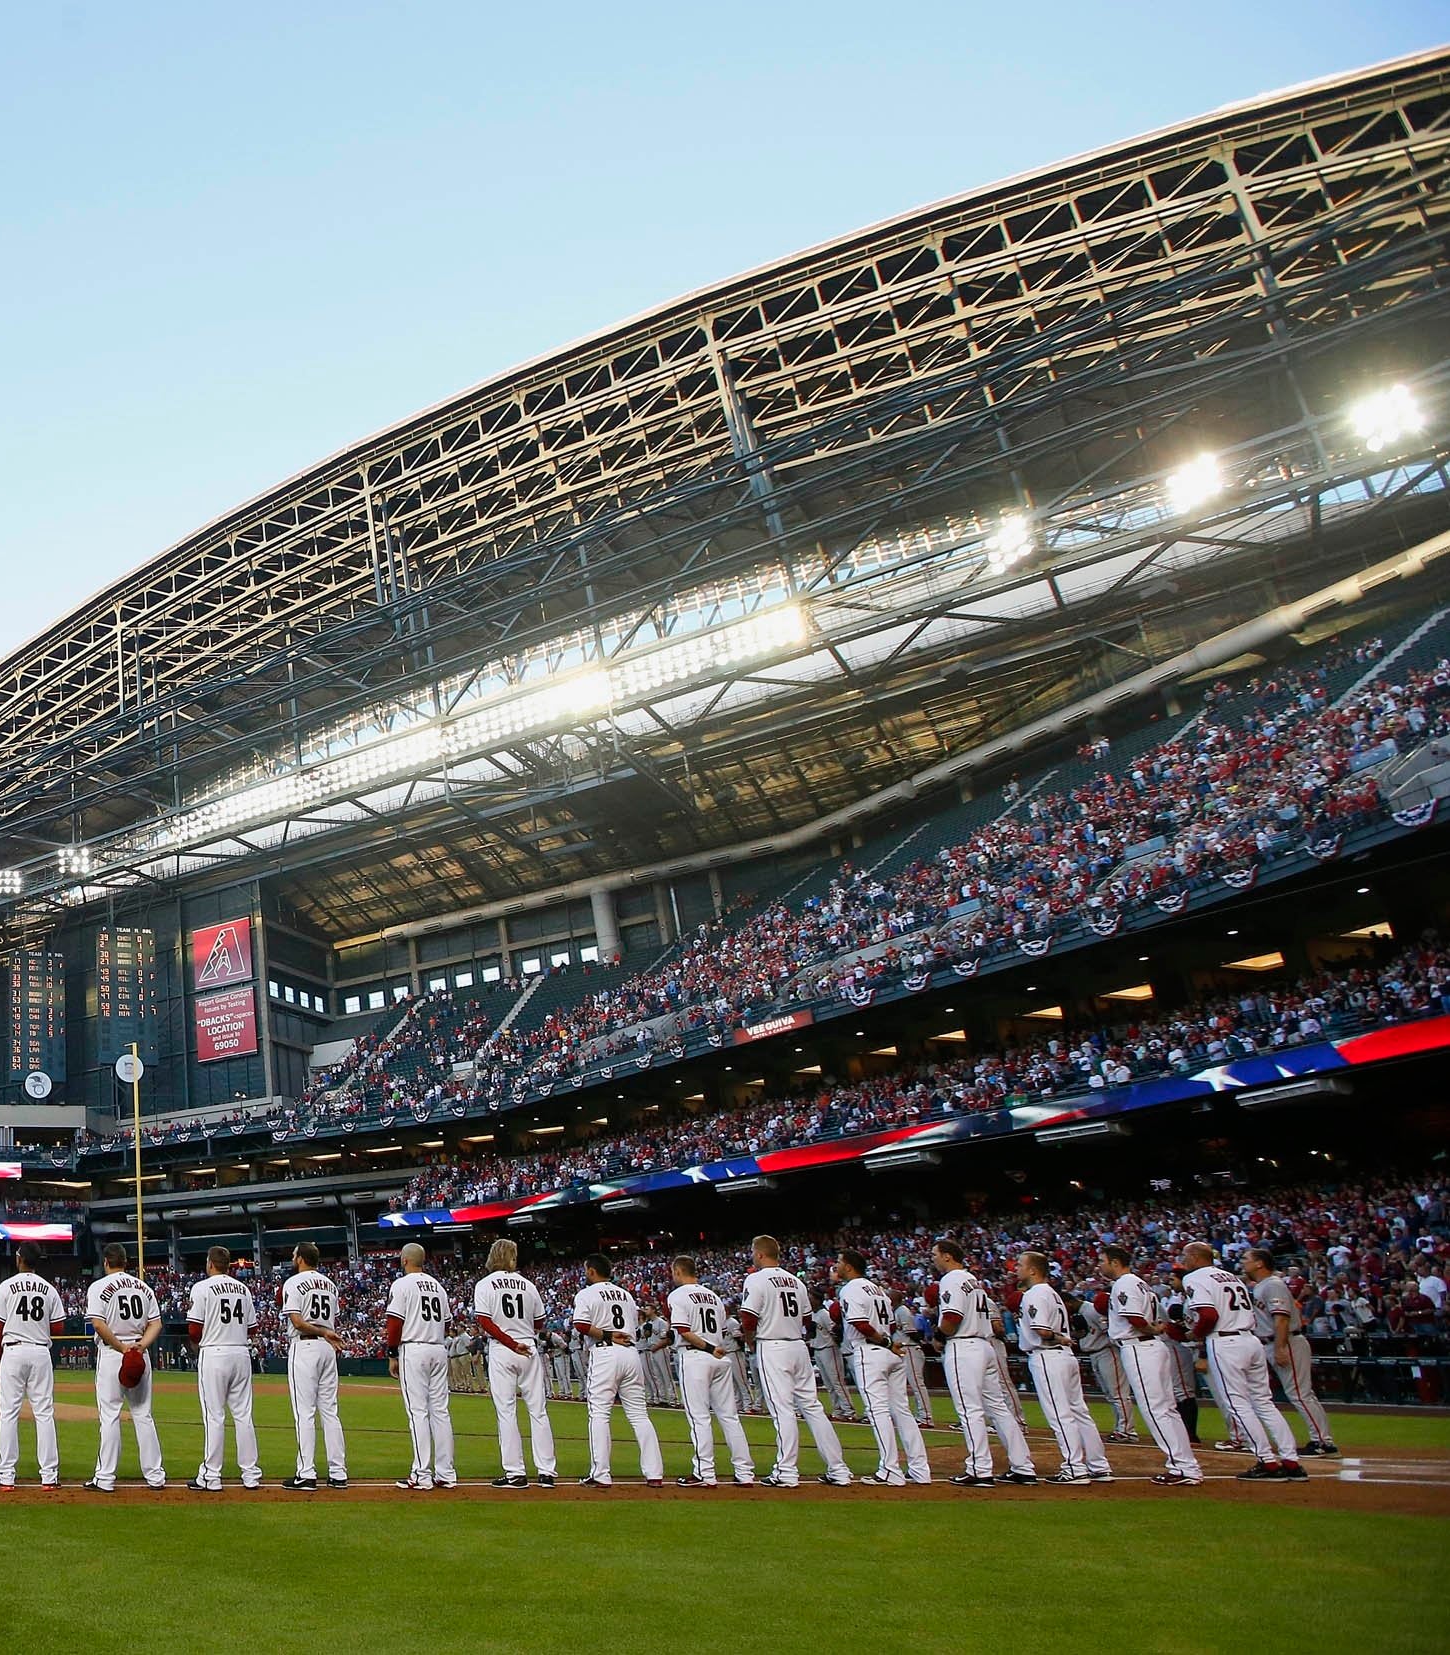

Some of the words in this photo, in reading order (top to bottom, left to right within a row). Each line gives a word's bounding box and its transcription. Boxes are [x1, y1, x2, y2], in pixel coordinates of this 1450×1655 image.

[207, 1021, 244, 1036] LOCATION
[746, 1024, 765, 1036] VEE
[765, 1016, 796, 1031] QUIVA
[214, 1039, 239, 1050] 69050
[9, 1281, 50, 1295] DELGADO
[99, 1278, 154, 1303] ROWLAND-SMITH
[209, 1281, 247, 1296] THATCHER
[416, 1281, 439, 1293] PEREZ
[491, 1278, 527, 1291] ARROYO
[599, 1290, 628, 1302] PARRA
[768, 1277, 799, 1290] TRUMBO
[15, 1295, 45, 1322] 48
[118, 1294, 144, 1321] 50
[220, 1298, 244, 1324] 54
[310, 1294, 331, 1321] 55
[421, 1295, 443, 1323] 59
[501, 1293, 524, 1320] 61
[780, 1291, 799, 1317] 15
[1224, 1286, 1251, 1311] 23
[611, 1304, 626, 1330] 8
[699, 1307, 717, 1333] 16
[874, 1299, 888, 1324] 14
